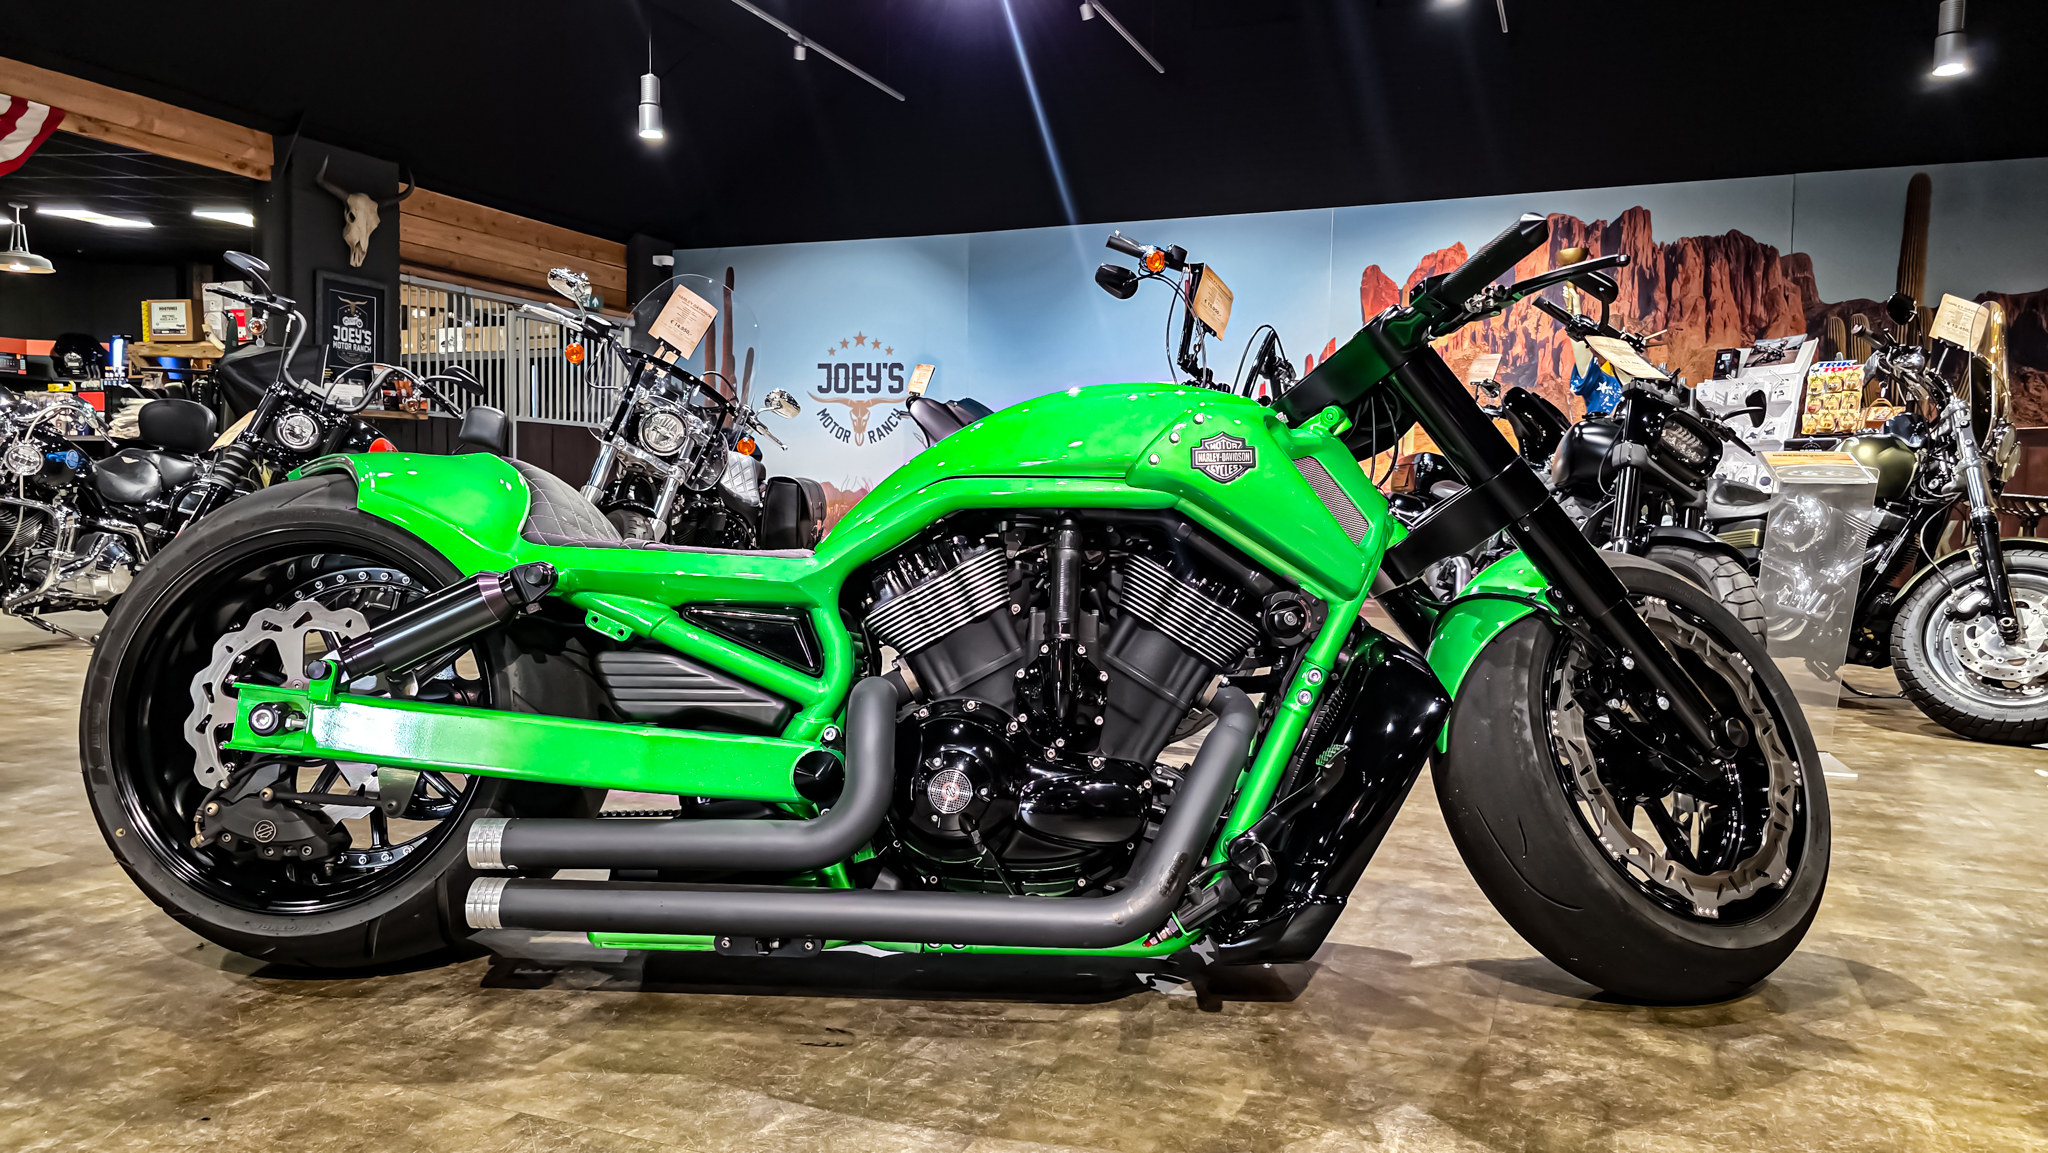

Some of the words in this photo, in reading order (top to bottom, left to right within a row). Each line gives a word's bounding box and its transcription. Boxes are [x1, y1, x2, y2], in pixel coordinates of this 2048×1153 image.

[332, 324, 372, 346] JOEY'S
[332, 340, 353, 351] MOTOR
[352, 343, 372, 354] RANCH
[817, 362, 905, 394] JOEY'S
[816, 407, 852, 444] MOTOR
[867, 407, 903, 445] RANCH
[1209, 438, 1239, 450] MOTOR
[1197, 451, 1251, 463] HARLEY-DAVIDSON
[1210, 464, 1239, 476] CYCLES
